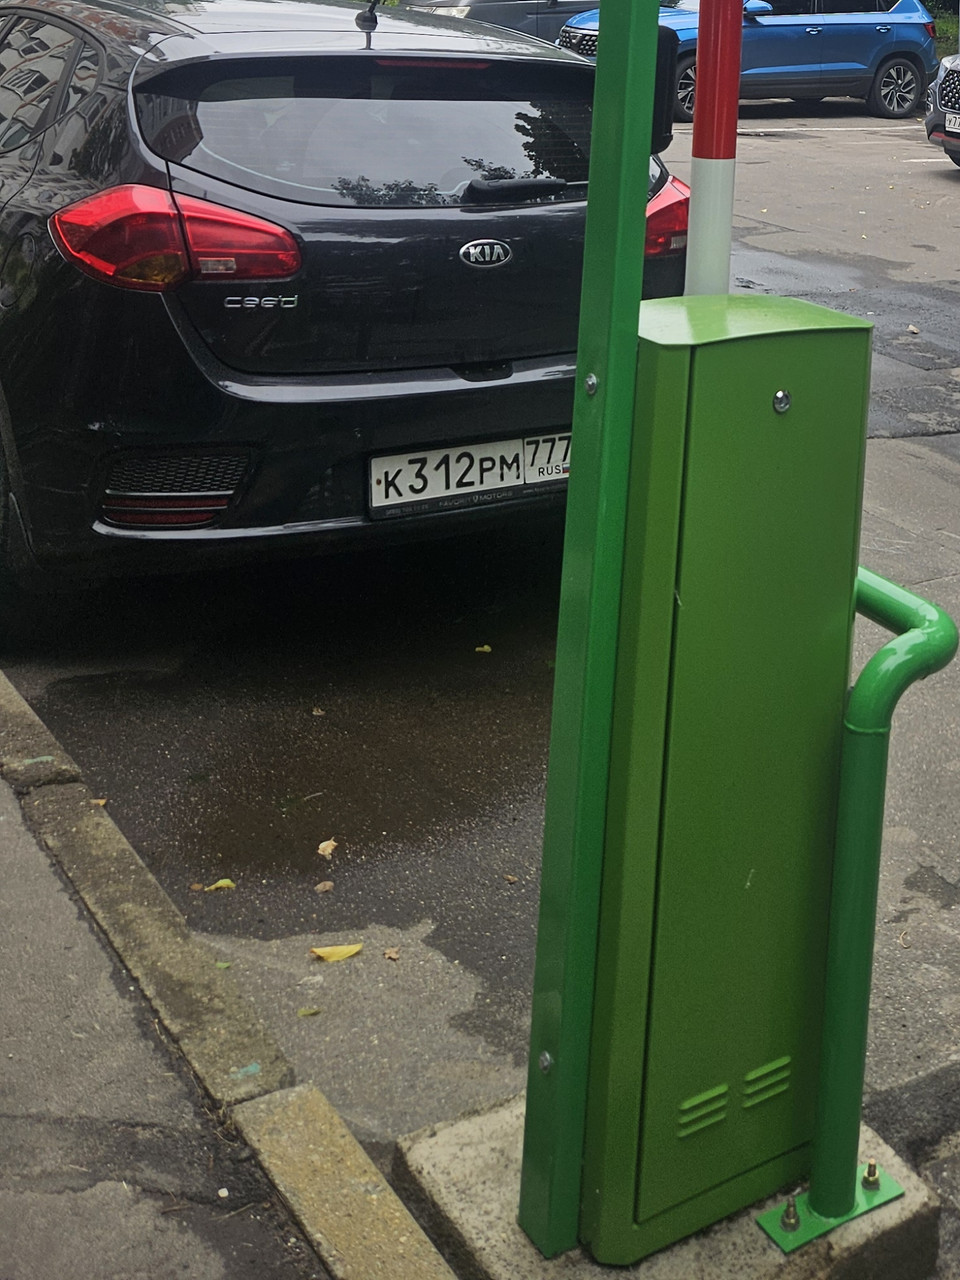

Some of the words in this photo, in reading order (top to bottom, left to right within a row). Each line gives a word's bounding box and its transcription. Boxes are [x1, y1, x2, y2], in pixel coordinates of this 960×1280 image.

[469, 244, 505, 262] KIA
[525, 435, 572, 468] 777
[538, 464, 562, 477] RUS
